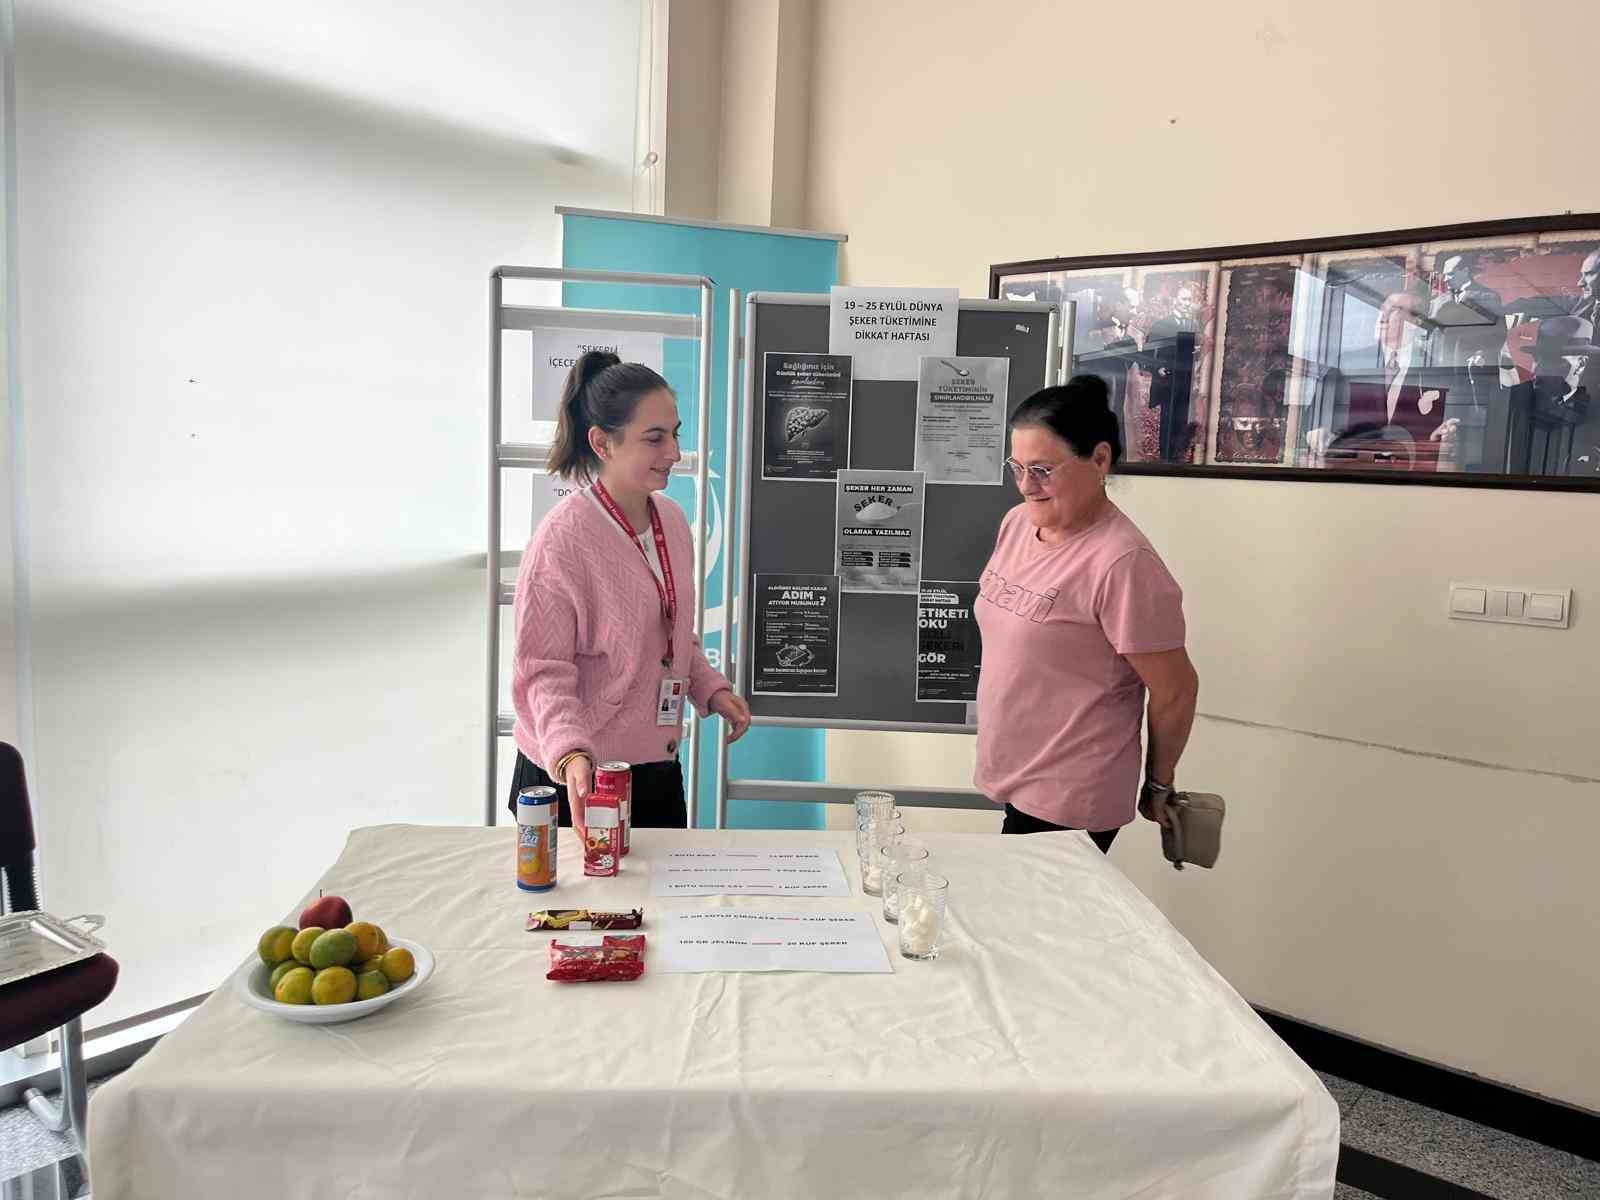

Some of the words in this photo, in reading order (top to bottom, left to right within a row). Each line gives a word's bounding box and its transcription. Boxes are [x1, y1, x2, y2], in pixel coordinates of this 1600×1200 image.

[844, 301, 856, 310] 19
[866, 301, 878, 310] 25
[880, 300, 908, 311] EYLÜL
[909, 301, 943, 312] DÜNYA
[849, 316, 878, 326] ŞEKER
[880, 315, 937, 327] TÜKETİMİNE
[855, 330, 889, 340] DİKKAT
[891, 331, 930, 341] HAFTASI
[782, 591, 814, 600] ADIM
[980, 569, 1060, 624] mavi
[919, 619, 948, 629] OKU
[919, 652, 947, 663] GÖR
